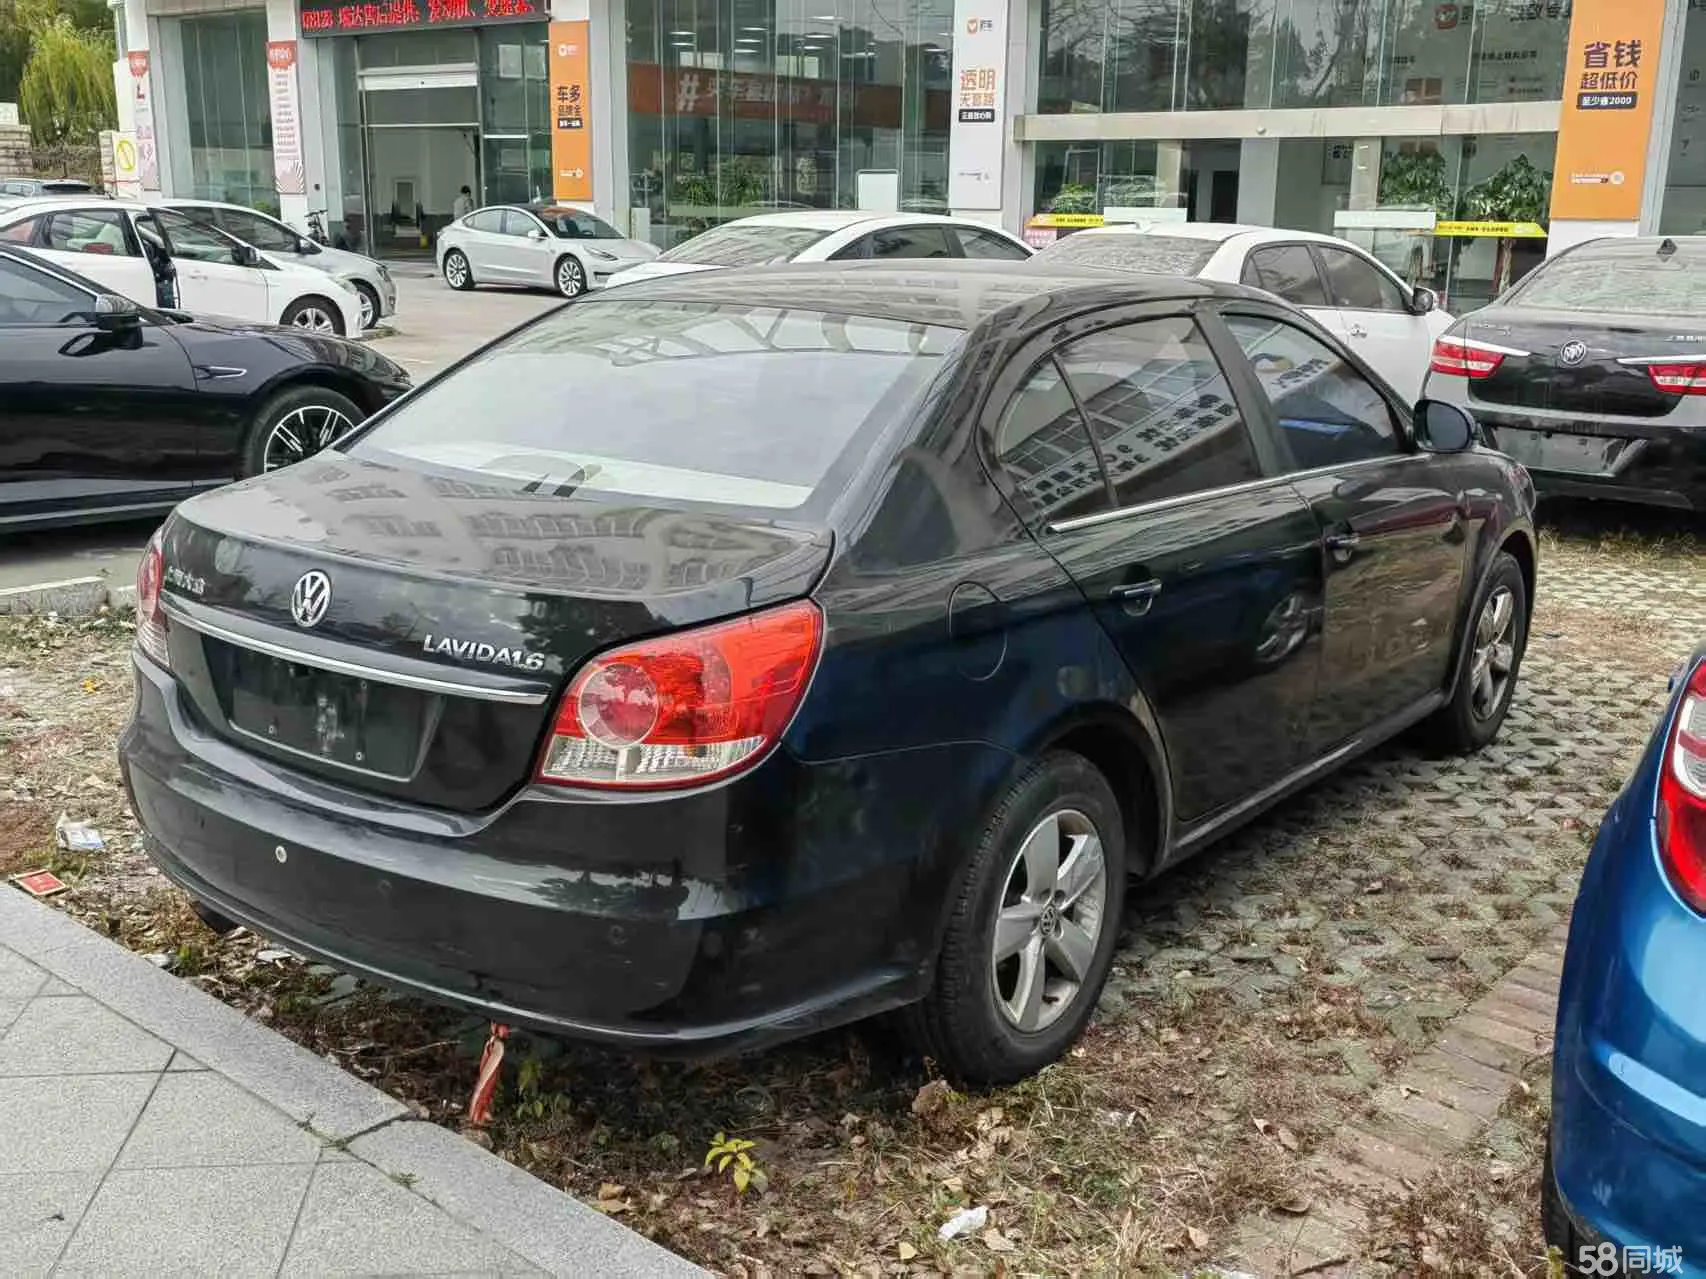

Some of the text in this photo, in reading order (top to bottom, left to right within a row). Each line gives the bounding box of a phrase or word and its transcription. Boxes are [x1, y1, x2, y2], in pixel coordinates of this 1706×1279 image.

[1584, 40, 1641, 69] 省钱
[960, 69, 995, 90] 透明
[1580, 72, 1638, 89] 超低价
[557, 84, 581, 103] 车多
